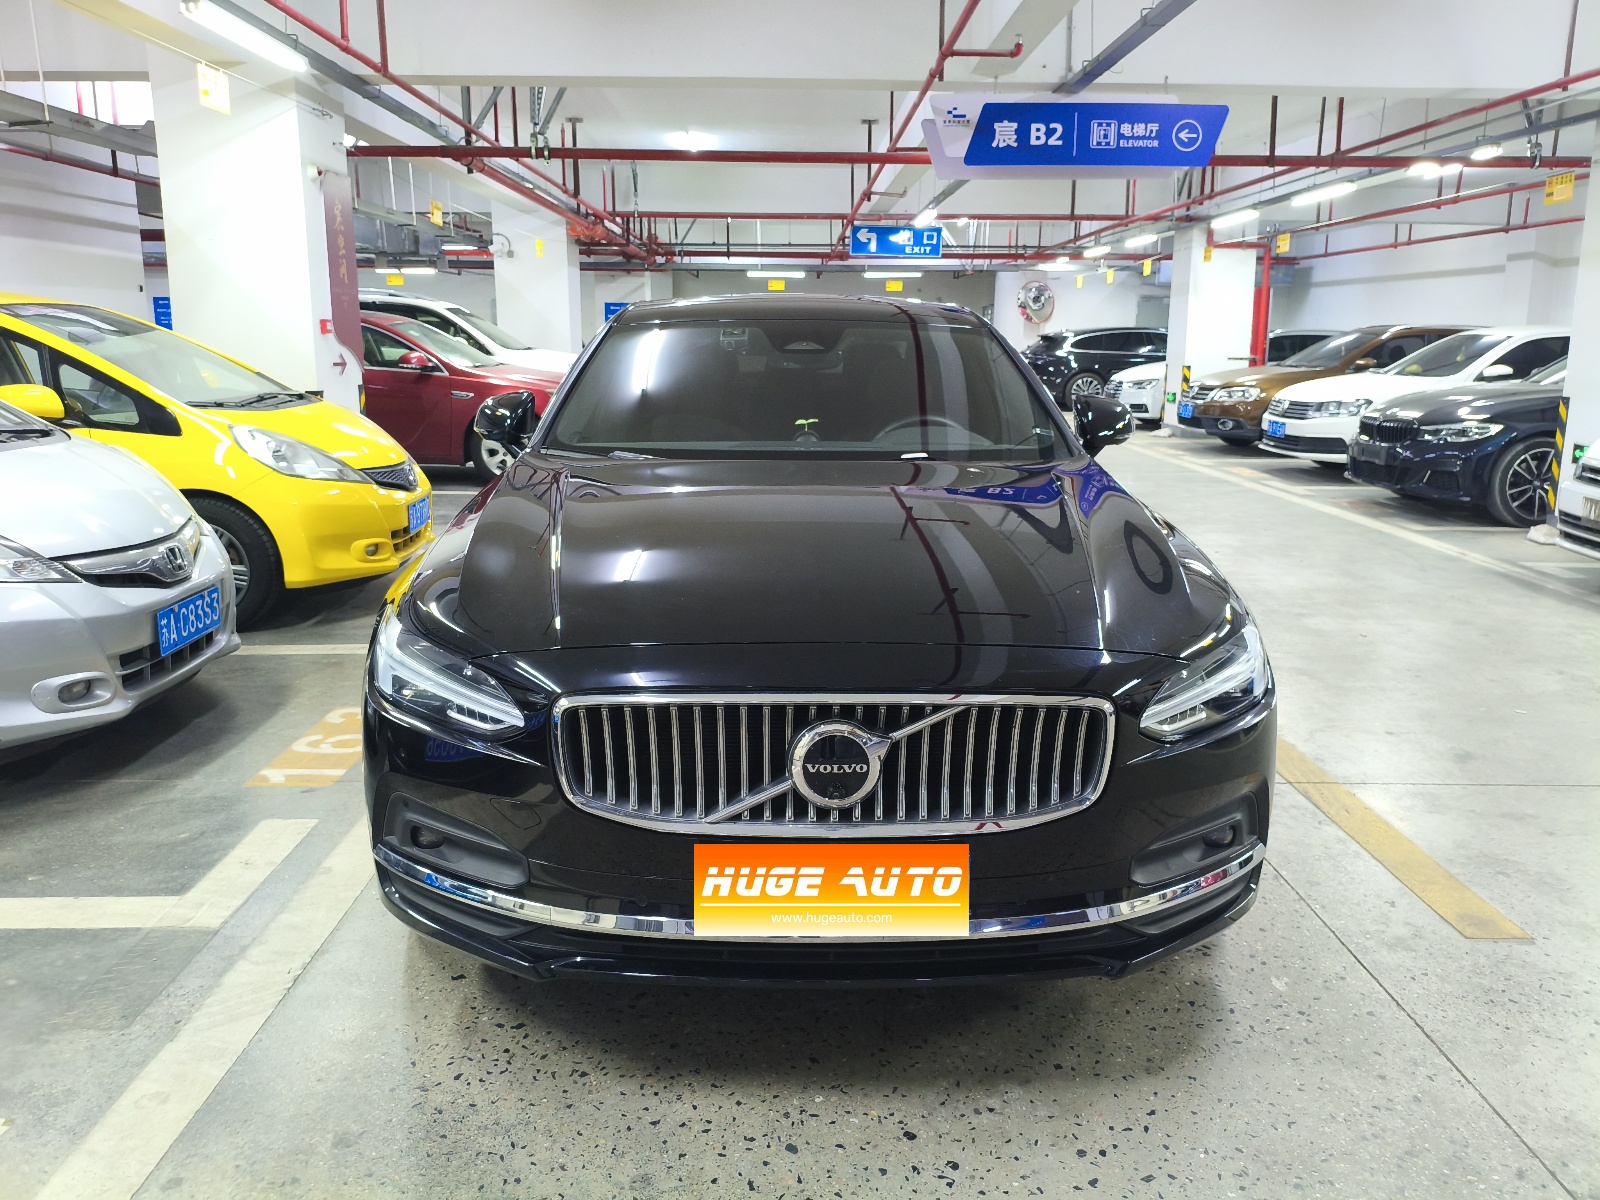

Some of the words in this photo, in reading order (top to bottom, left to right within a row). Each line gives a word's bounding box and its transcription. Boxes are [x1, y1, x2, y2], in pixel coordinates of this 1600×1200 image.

[991, 120, 1018, 148] 宸
[1030, 123, 1063, 146] B2
[1120, 123, 1159, 137] 电梯厅
[1120, 140, 1159, 148] ELEVATOR
[905, 246, 931, 254] EXIT
[805, 763, 868, 774] VOLVO
